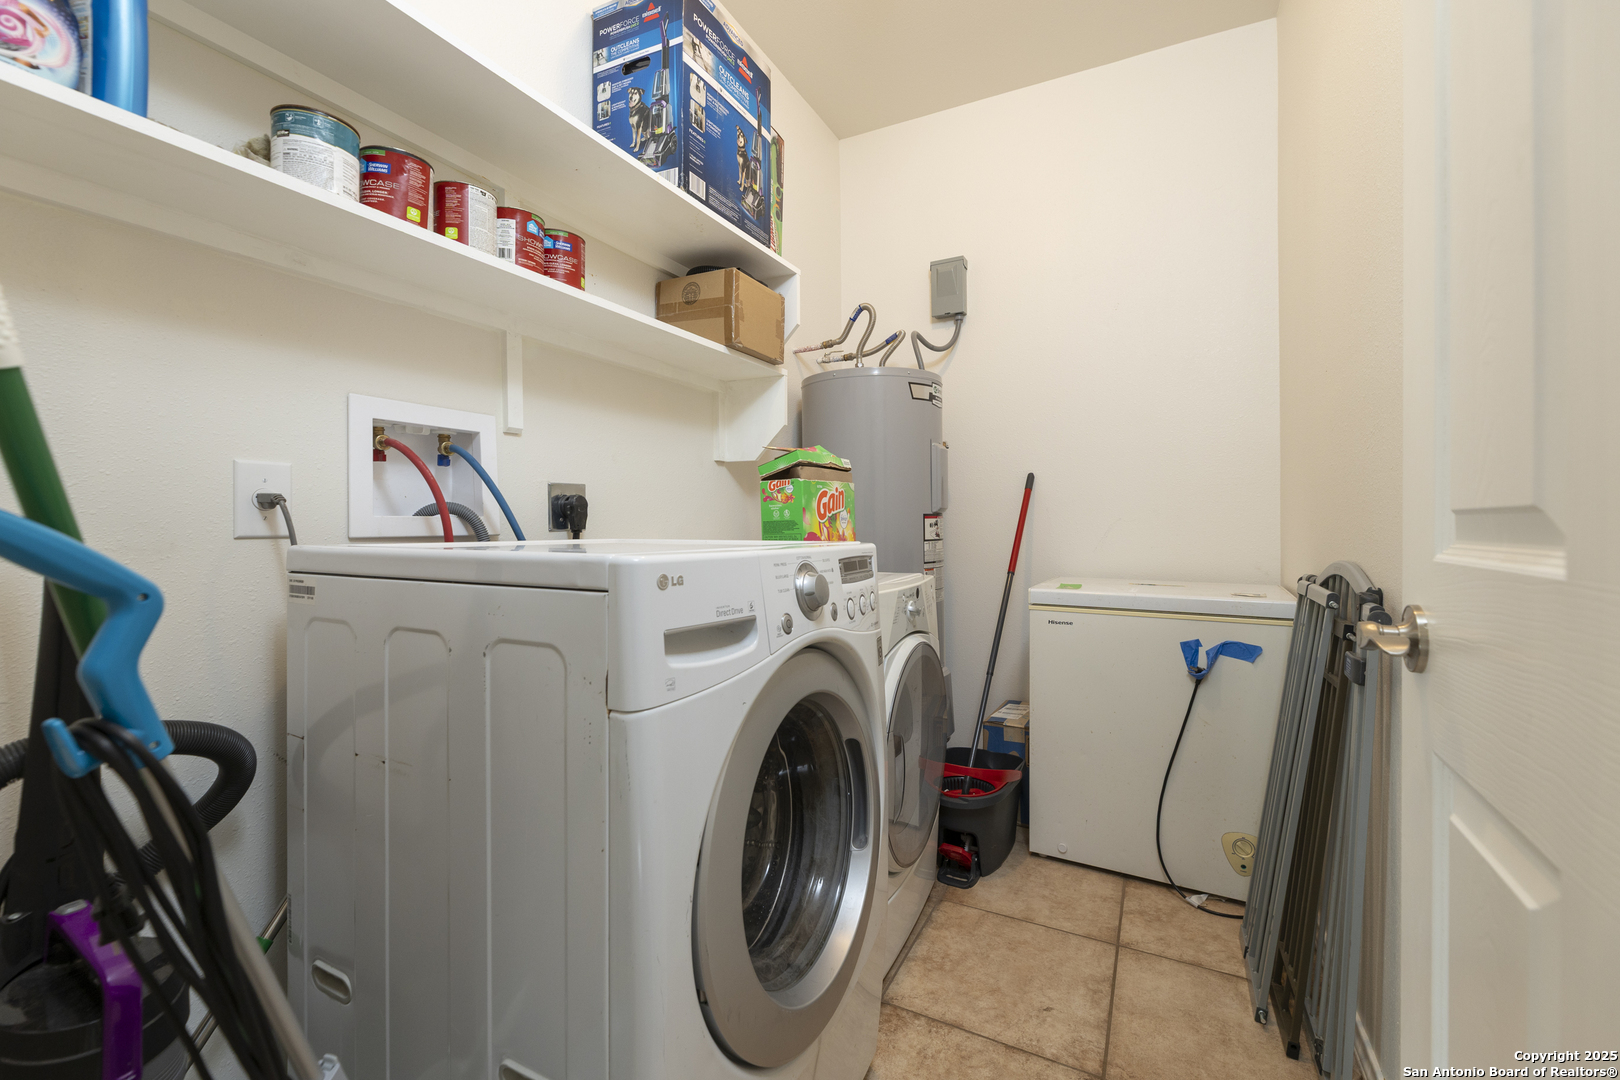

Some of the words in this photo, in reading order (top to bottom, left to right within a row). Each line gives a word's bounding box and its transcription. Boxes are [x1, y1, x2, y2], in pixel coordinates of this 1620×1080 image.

[599, 15, 640, 37] POWERFORCE
[693, 13, 736, 60] POWERFORCE
[610, 37, 640, 53] OUTCLEANS
[719, 65, 750, 100] OUTCLEANS
[816, 486, 845, 521] Gain
[671, 575, 684, 586] LG
[716, 609, 731, 618] Direct
[731, 608, 743, 616] Drive
